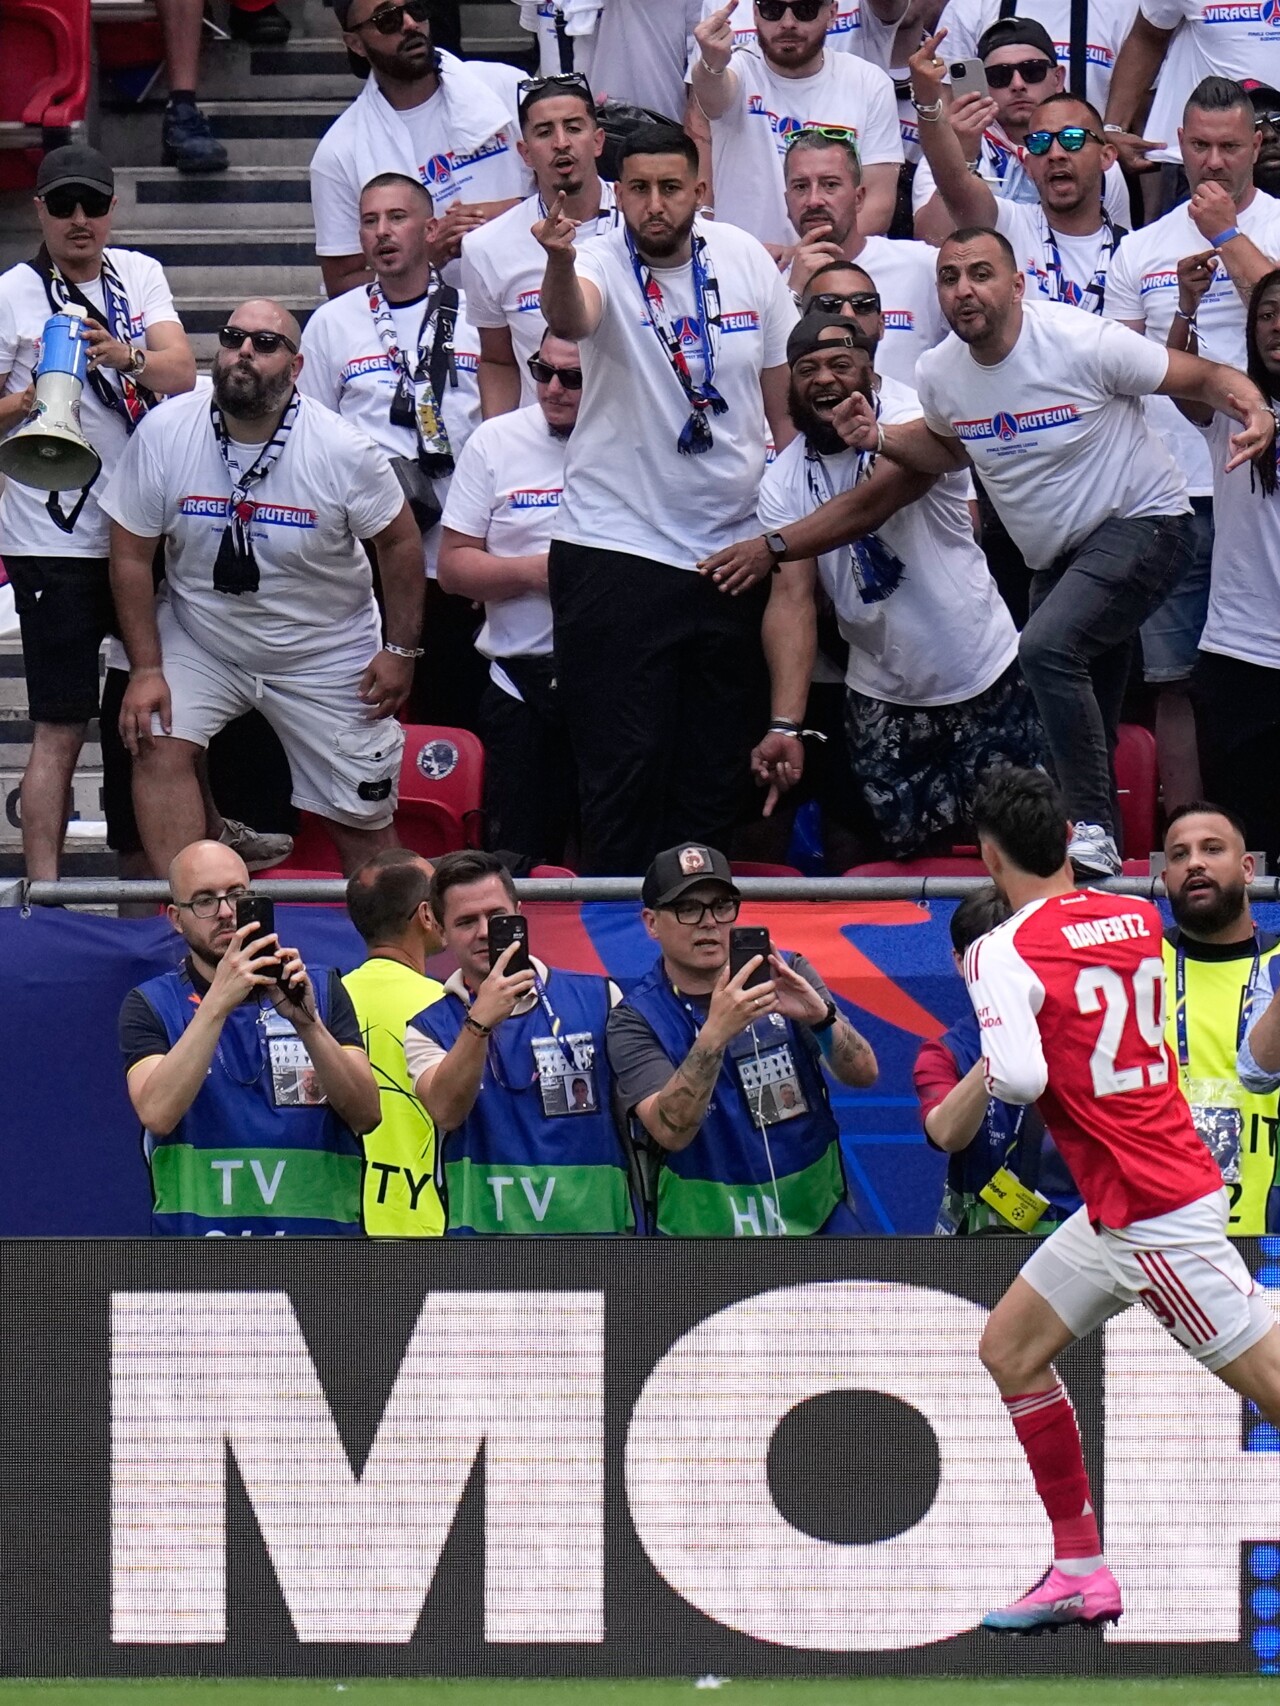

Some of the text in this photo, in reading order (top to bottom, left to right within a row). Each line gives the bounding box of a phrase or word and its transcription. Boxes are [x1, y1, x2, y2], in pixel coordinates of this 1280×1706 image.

[1206, 6, 1259, 21] VIRAGE
[721, 313, 755, 330] TEUIL
[341, 357, 388, 380] VIRAGE
[955, 407, 1075, 439] VIRAGE AUTEUIL
[183, 499, 313, 525] IRAGE AUTEUIL
[1060, 913, 1150, 949] HAVERTZ
[1074, 956, 1169, 1099] 29
[211, 1160, 286, 1205] TV
[487, 1176, 555, 1222] TV
